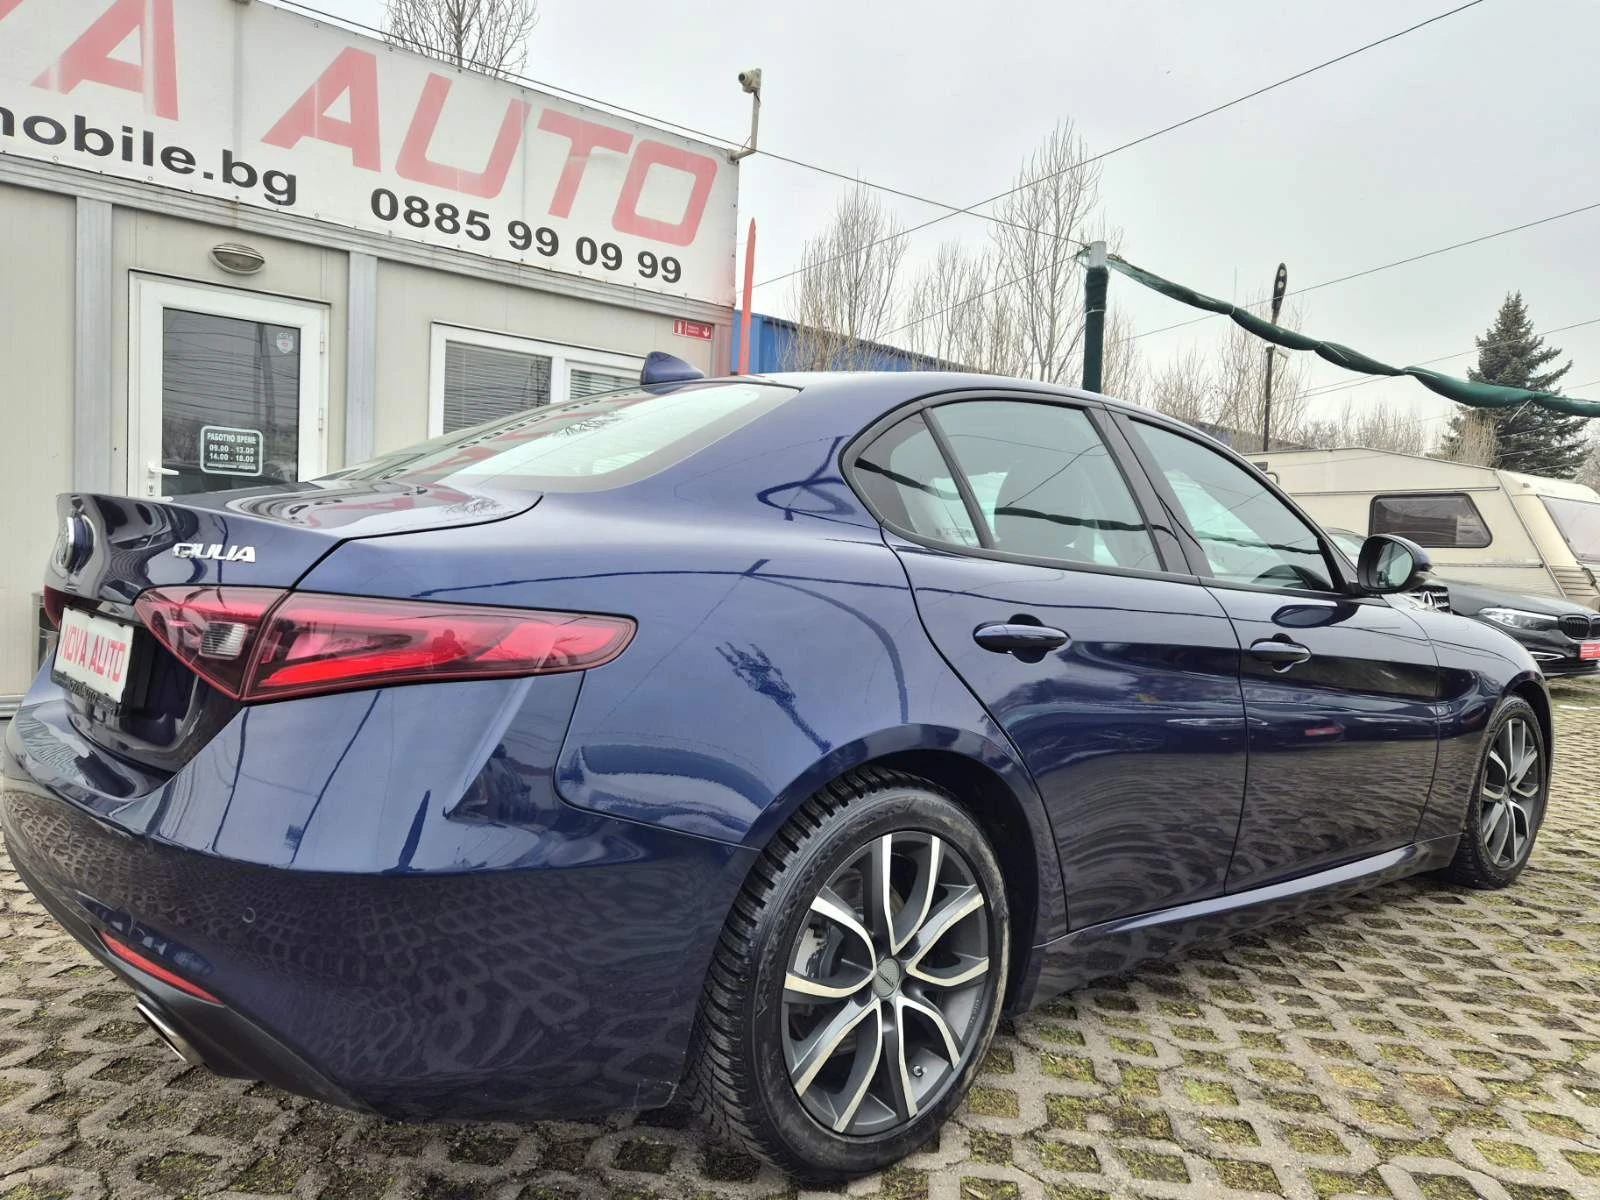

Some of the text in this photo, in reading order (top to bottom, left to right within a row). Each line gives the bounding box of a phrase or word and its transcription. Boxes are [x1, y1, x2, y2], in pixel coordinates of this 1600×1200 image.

[260, 45, 718, 246] AUTO
[370, 188, 682, 283] 0885 99 09 99
[172, 542, 256, 563] GIULIA
[89, 635, 126, 682] AUTO
